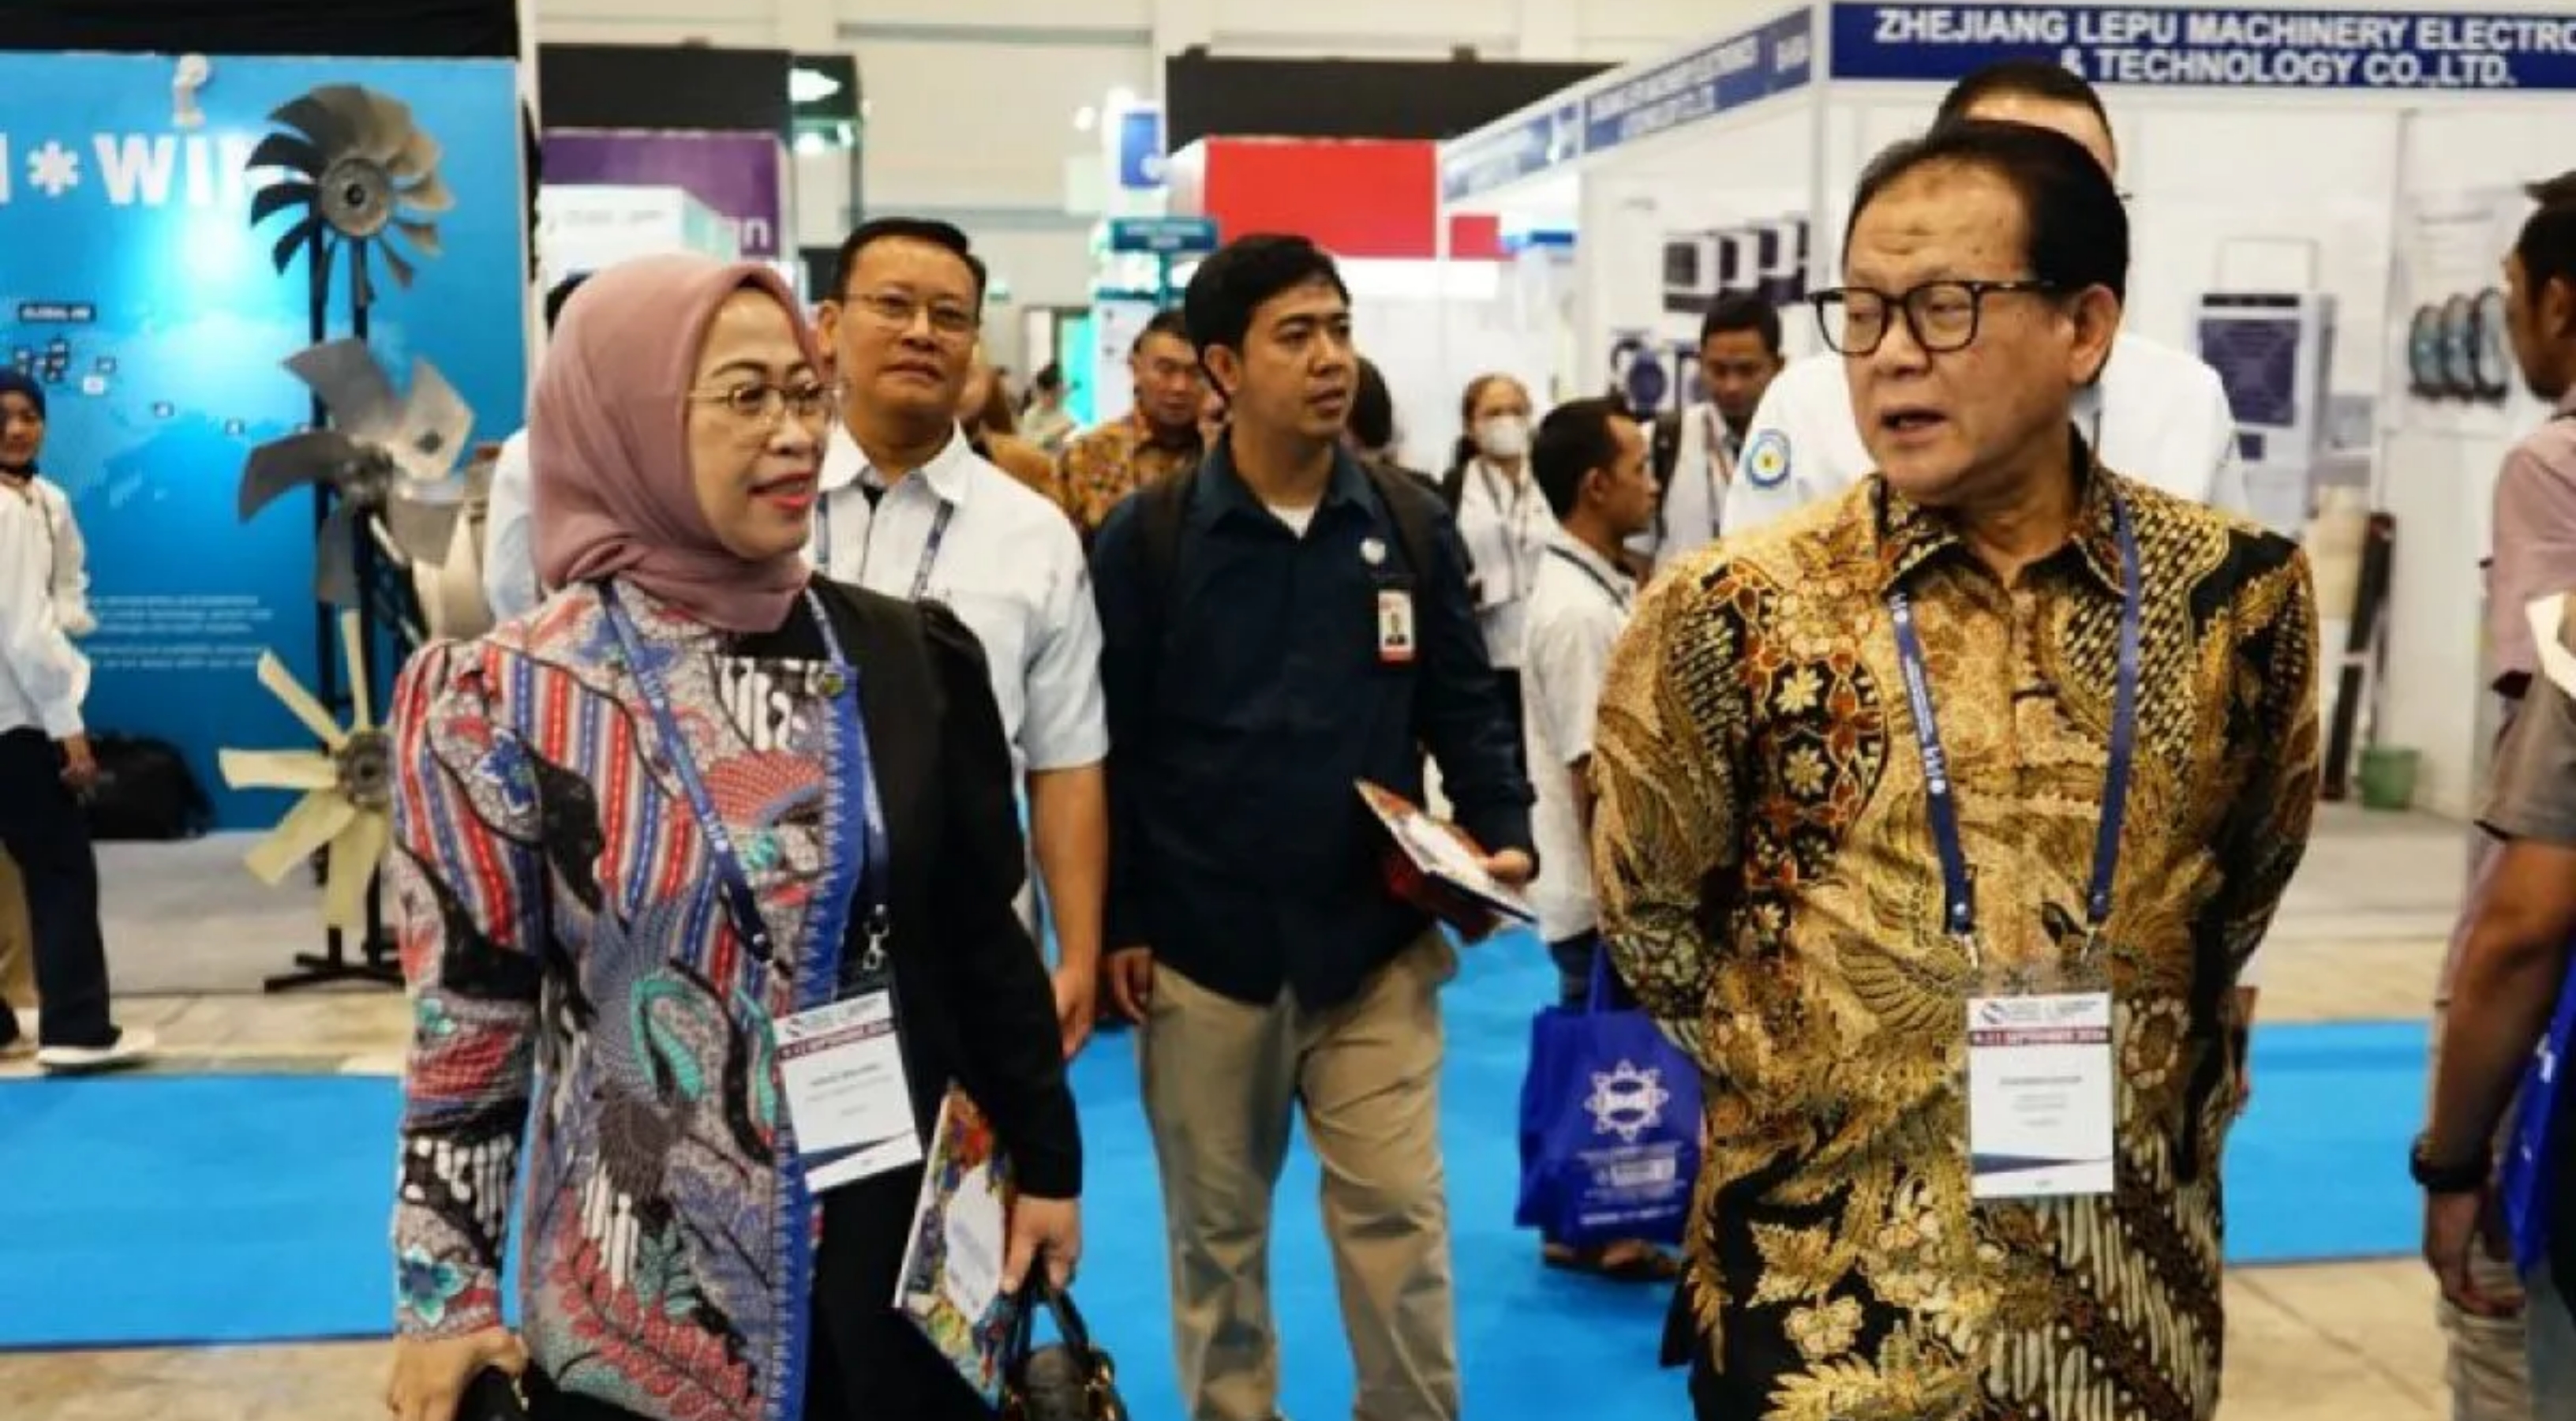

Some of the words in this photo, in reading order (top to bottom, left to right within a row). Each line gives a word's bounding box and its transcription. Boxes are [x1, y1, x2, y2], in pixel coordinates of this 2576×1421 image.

[1874, 9, 2067, 44] ZHEJIANG
[2077, 9, 2177, 45] LEPU
[2186, 12, 2409, 50] MACHINERY
[2061, 45, 2084, 77] &
[2095, 47, 2358, 84] TECHNOLOGY
